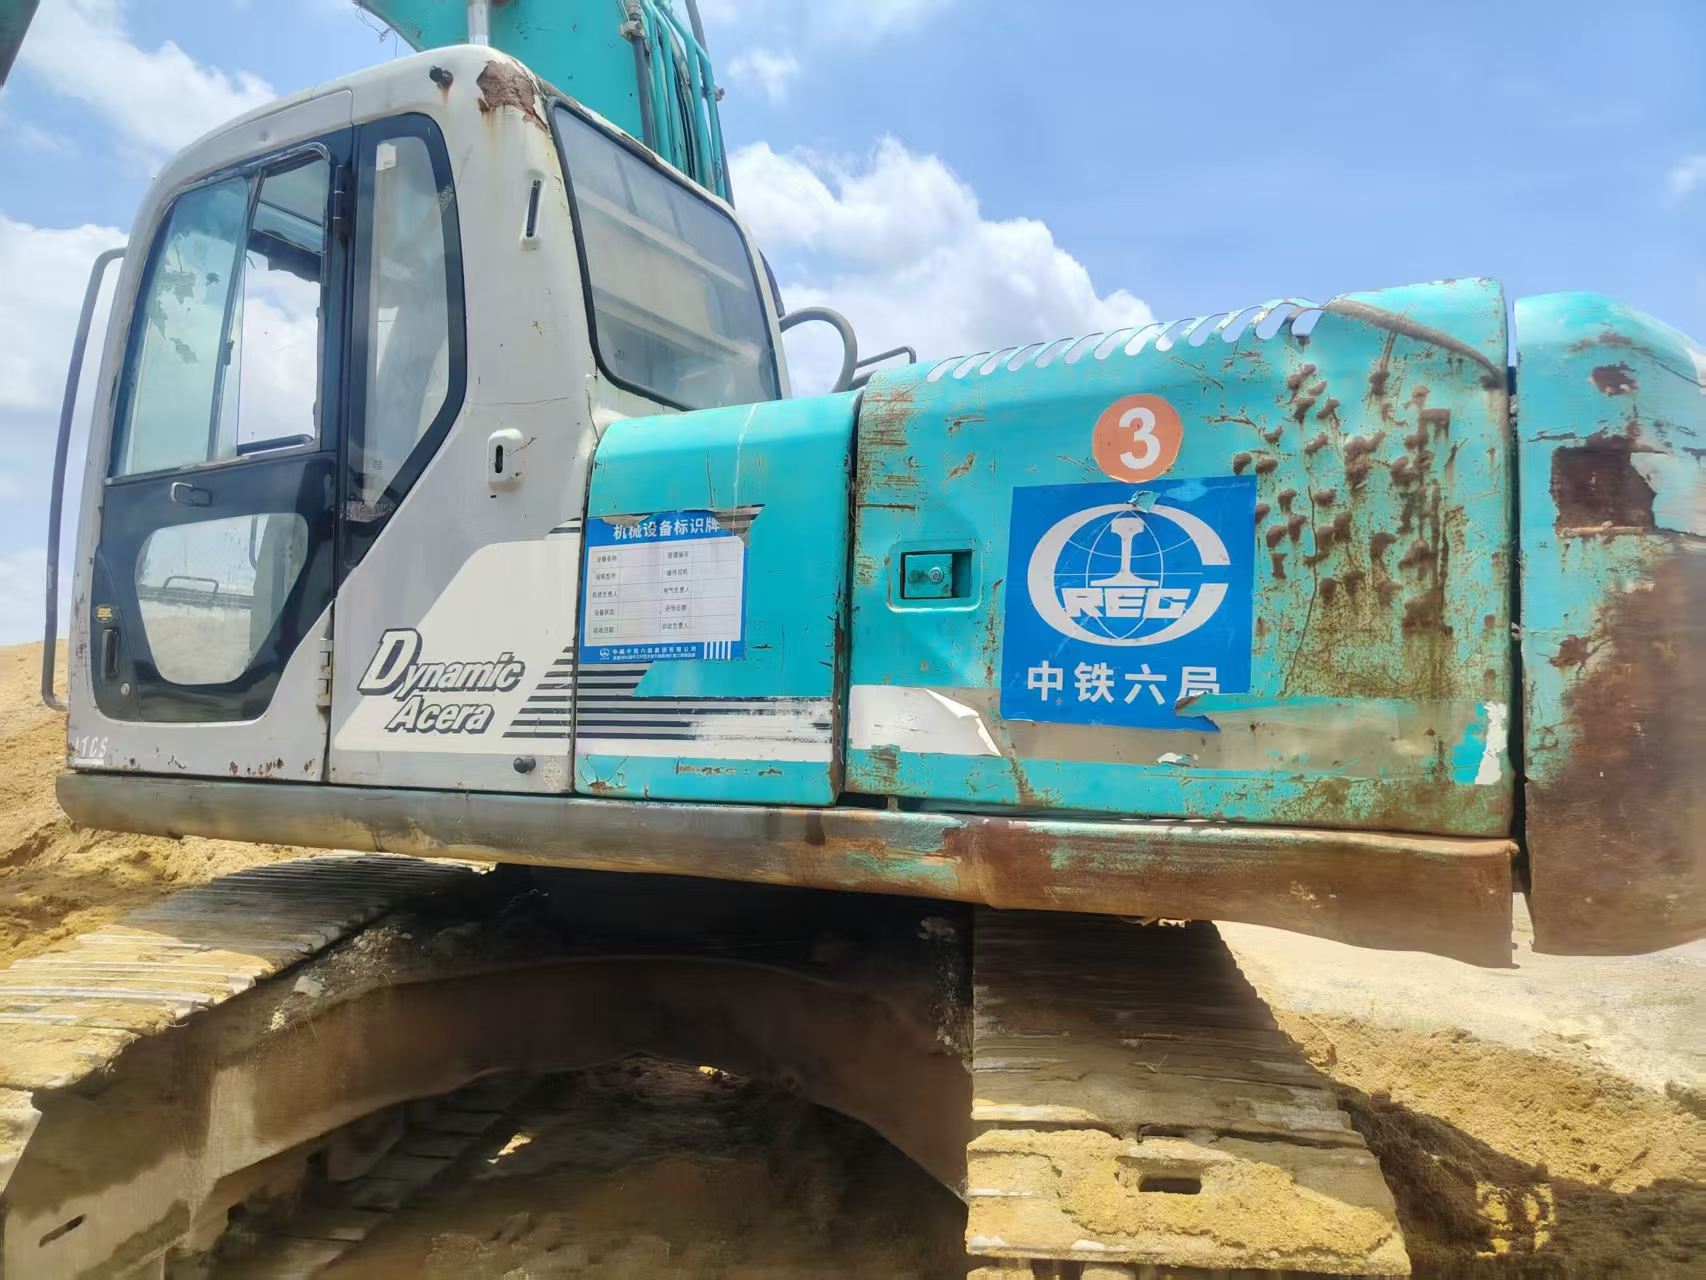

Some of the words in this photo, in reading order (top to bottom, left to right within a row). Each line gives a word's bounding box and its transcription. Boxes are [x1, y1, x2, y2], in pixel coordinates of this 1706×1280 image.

[1119, 407, 1160, 469] 3
[613, 516, 720, 540] 机械设备标识牌
[357, 627, 526, 702] Dynamic
[1027, 660, 1220, 705] 中铁六局
[384, 694, 496, 735] Acera
